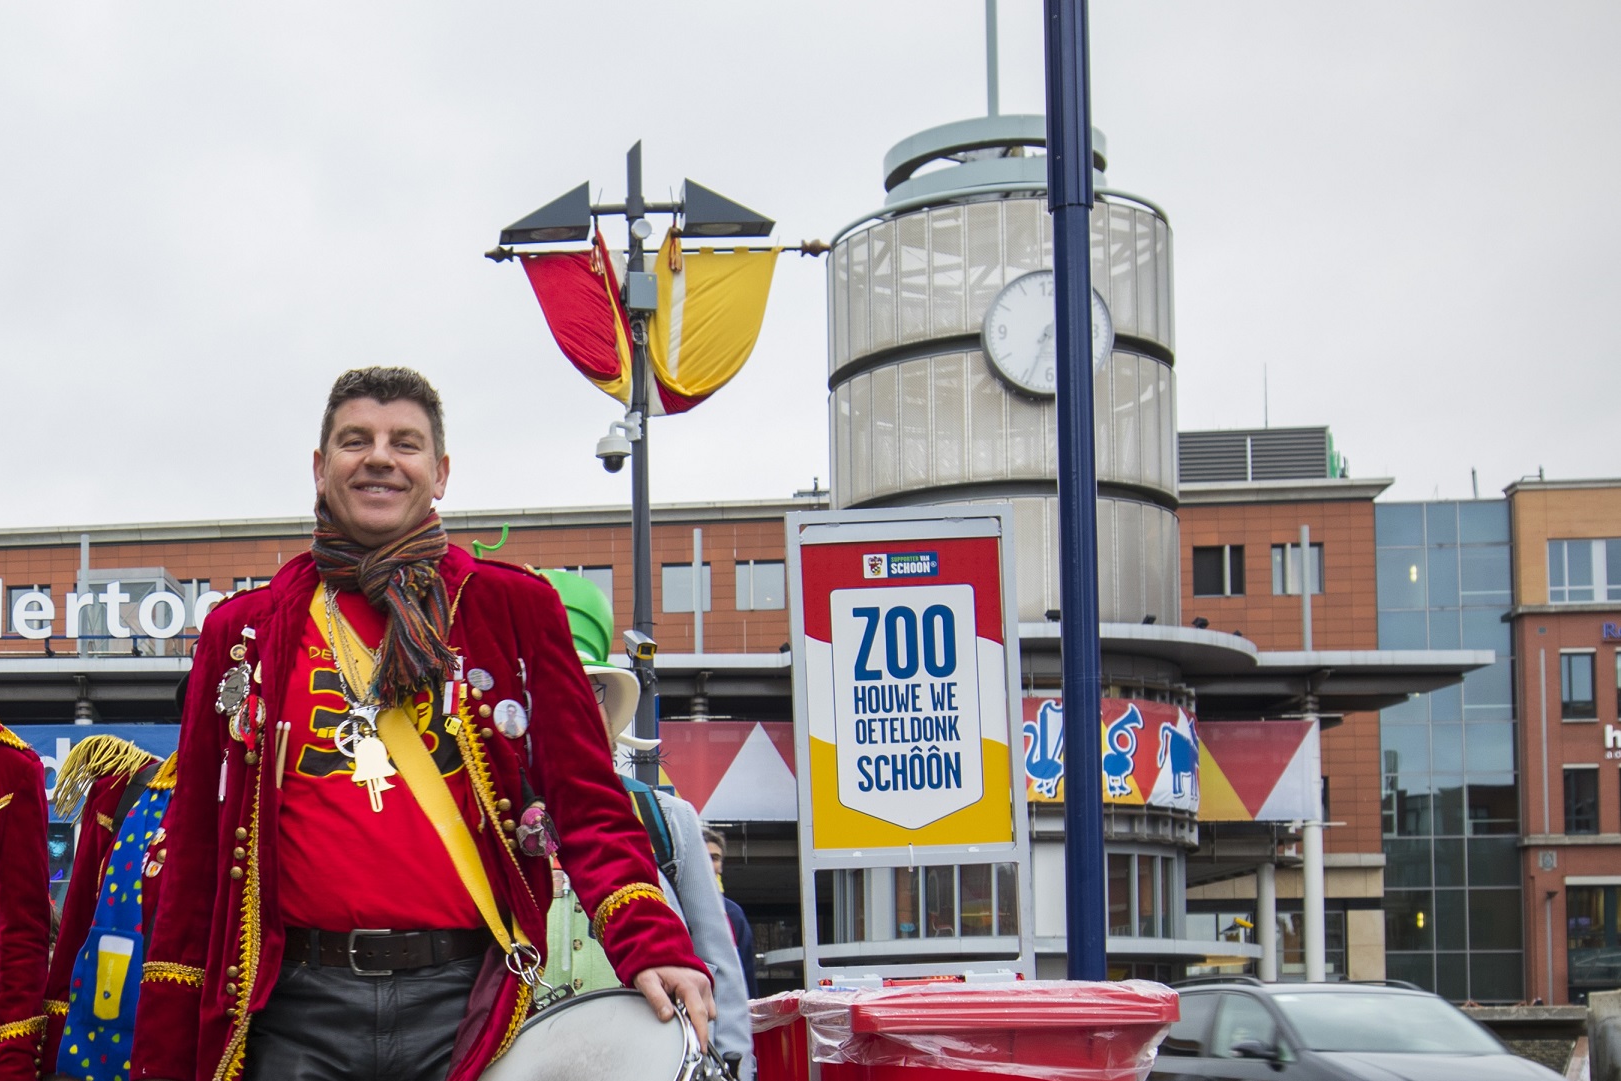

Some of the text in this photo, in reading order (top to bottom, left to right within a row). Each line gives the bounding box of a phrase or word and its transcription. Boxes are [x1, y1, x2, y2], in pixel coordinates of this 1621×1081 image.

[997, 324, 1008, 340] 9
[852, 604, 958, 682] ZOO
[853, 681, 959, 715] HOUWE WE
[855, 714, 961, 745] OETELDONK
[857, 744, 963, 793] SCHÔÔN
